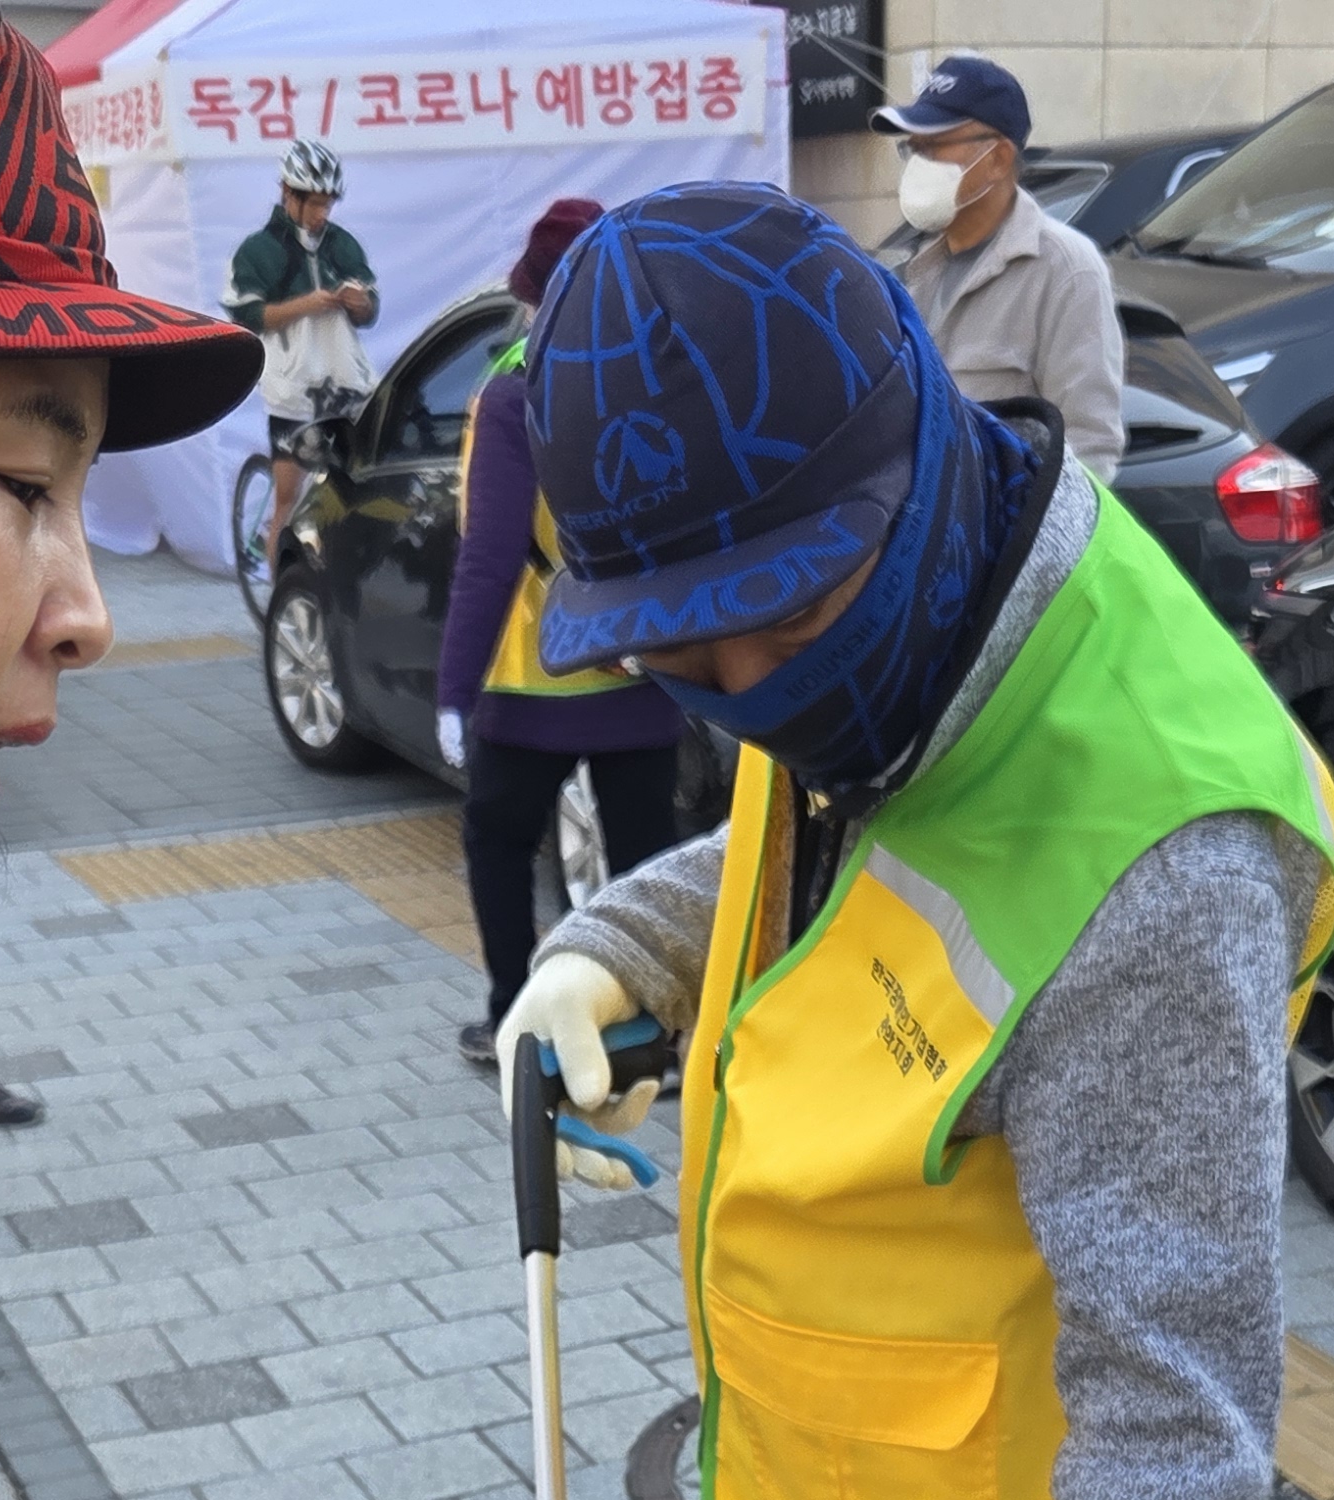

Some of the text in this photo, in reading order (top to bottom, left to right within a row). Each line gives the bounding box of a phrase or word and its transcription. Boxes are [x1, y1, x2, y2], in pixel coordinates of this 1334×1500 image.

[186, 56, 743, 142] 독감 / 코로나 예방접종
[871, 957, 948, 1082] 한국장애인기업협회
